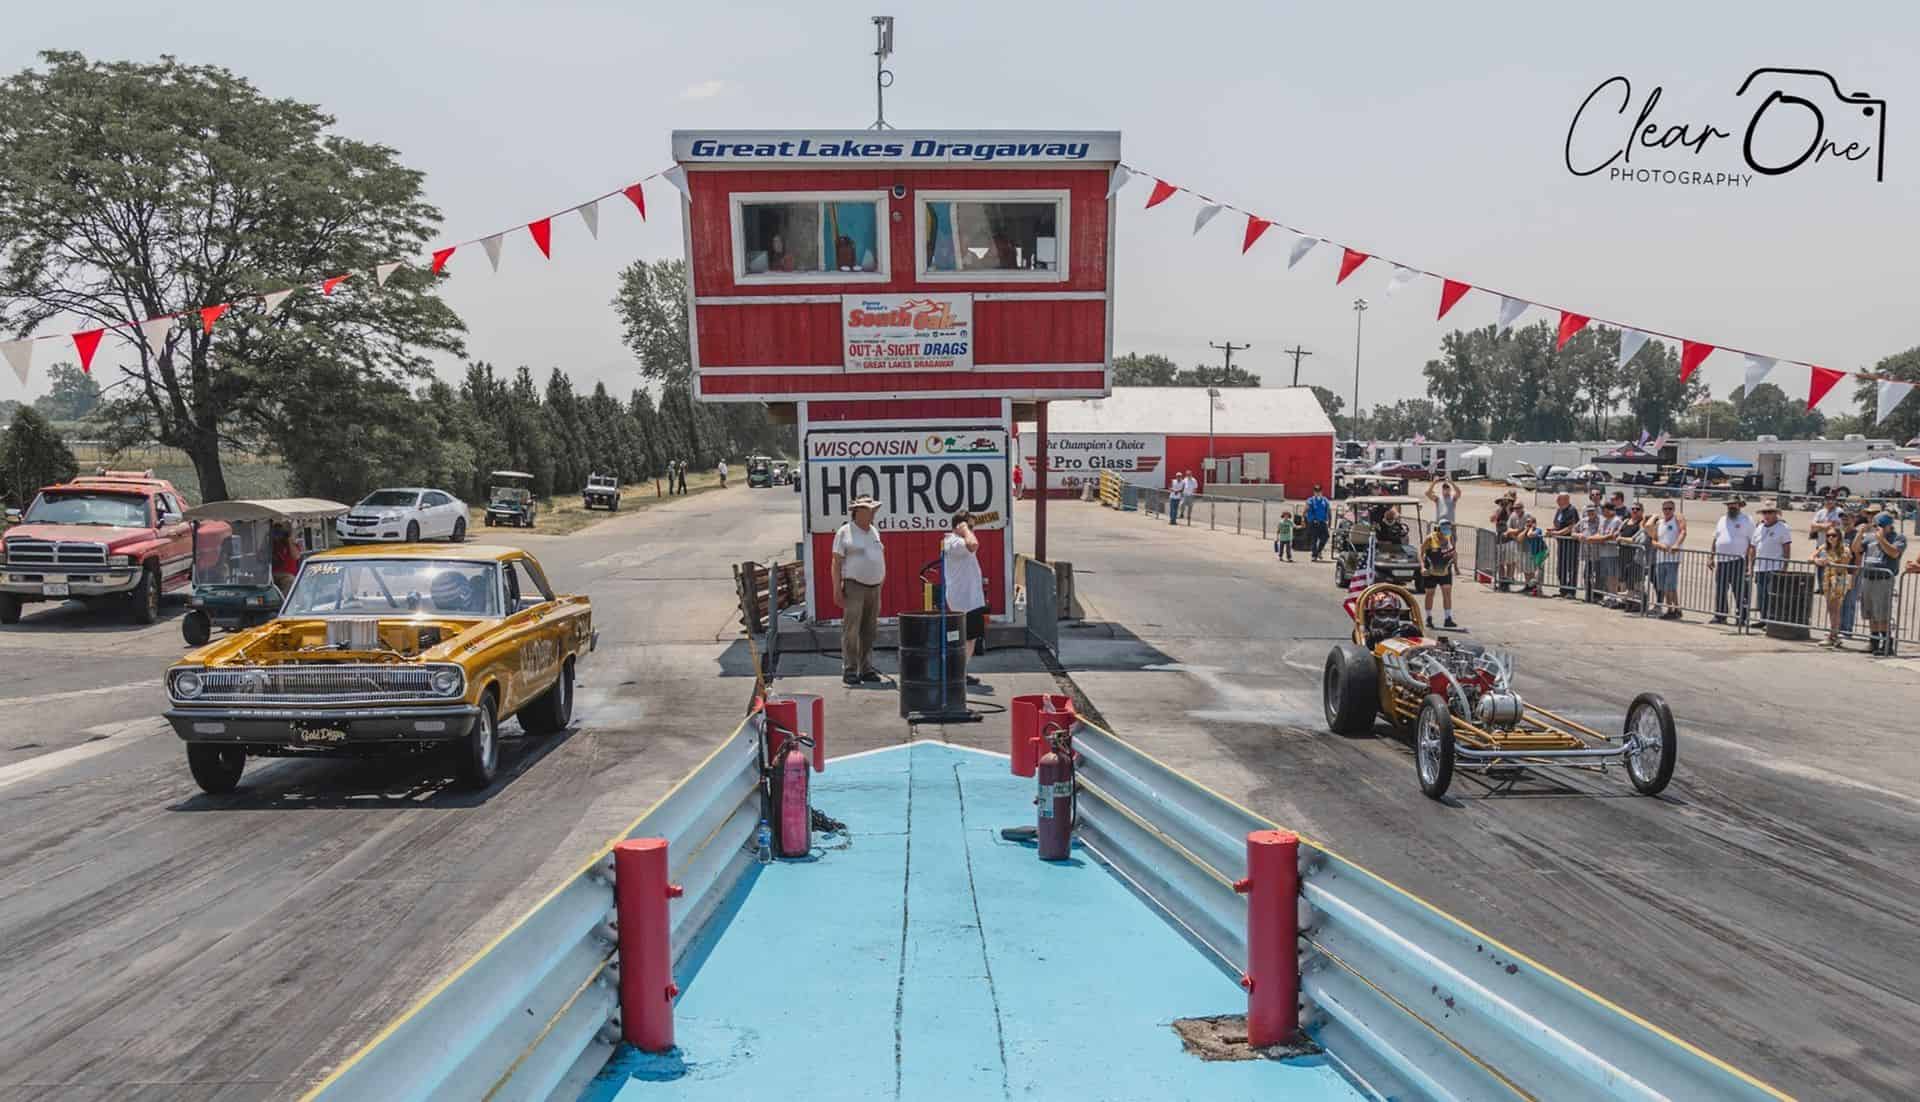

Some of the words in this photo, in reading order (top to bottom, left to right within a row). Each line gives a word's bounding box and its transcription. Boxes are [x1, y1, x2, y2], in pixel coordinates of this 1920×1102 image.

[691, 140, 795, 157] Great
[797, 140, 904, 157] Lakes
[911, 140, 1090, 161] Dragaway
[848, 308, 912, 328] South
[849, 343, 921, 357] OUT-A-SIGHT
[923, 342, 968, 356] DRAGS
[863, 360, 886, 369] GREAT
[888, 360, 912, 369] LAKES
[814, 439, 919, 457] WISCONSIN
[1059, 439, 1113, 452] Champion's
[1115, 439, 1146, 450] Choice
[1054, 456, 1082, 469] Pro
[1088, 455, 1134, 469] Glass
[821, 463, 994, 516] HOTROD
